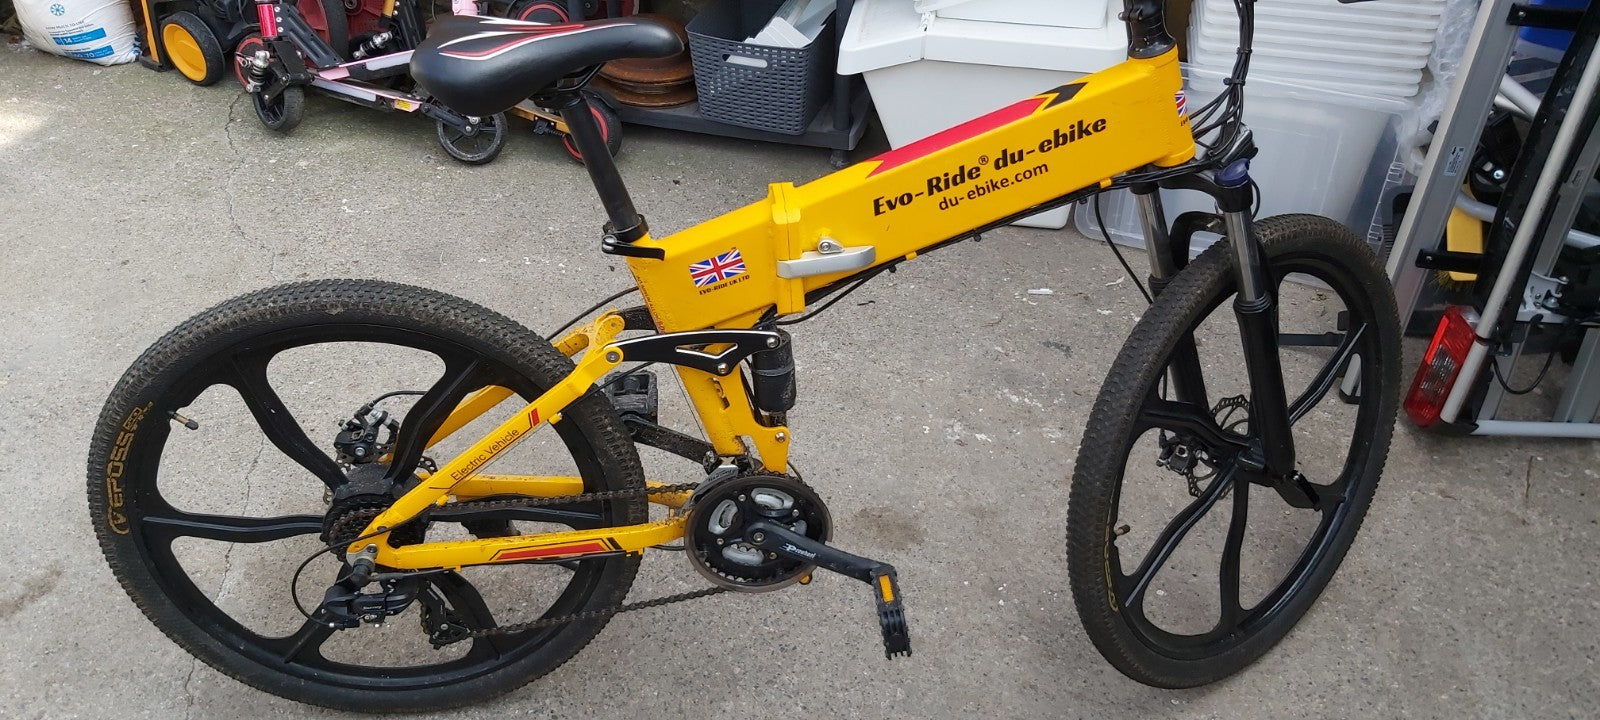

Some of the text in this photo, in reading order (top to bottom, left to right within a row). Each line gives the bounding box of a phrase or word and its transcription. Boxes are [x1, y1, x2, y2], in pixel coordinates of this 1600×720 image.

[993, 117, 1107, 171] du-ebike
[938, 162, 1049, 211] du-ebike.com
[729, 278, 739, 286] UK
[450, 428, 520, 481] Electric Vehicle
